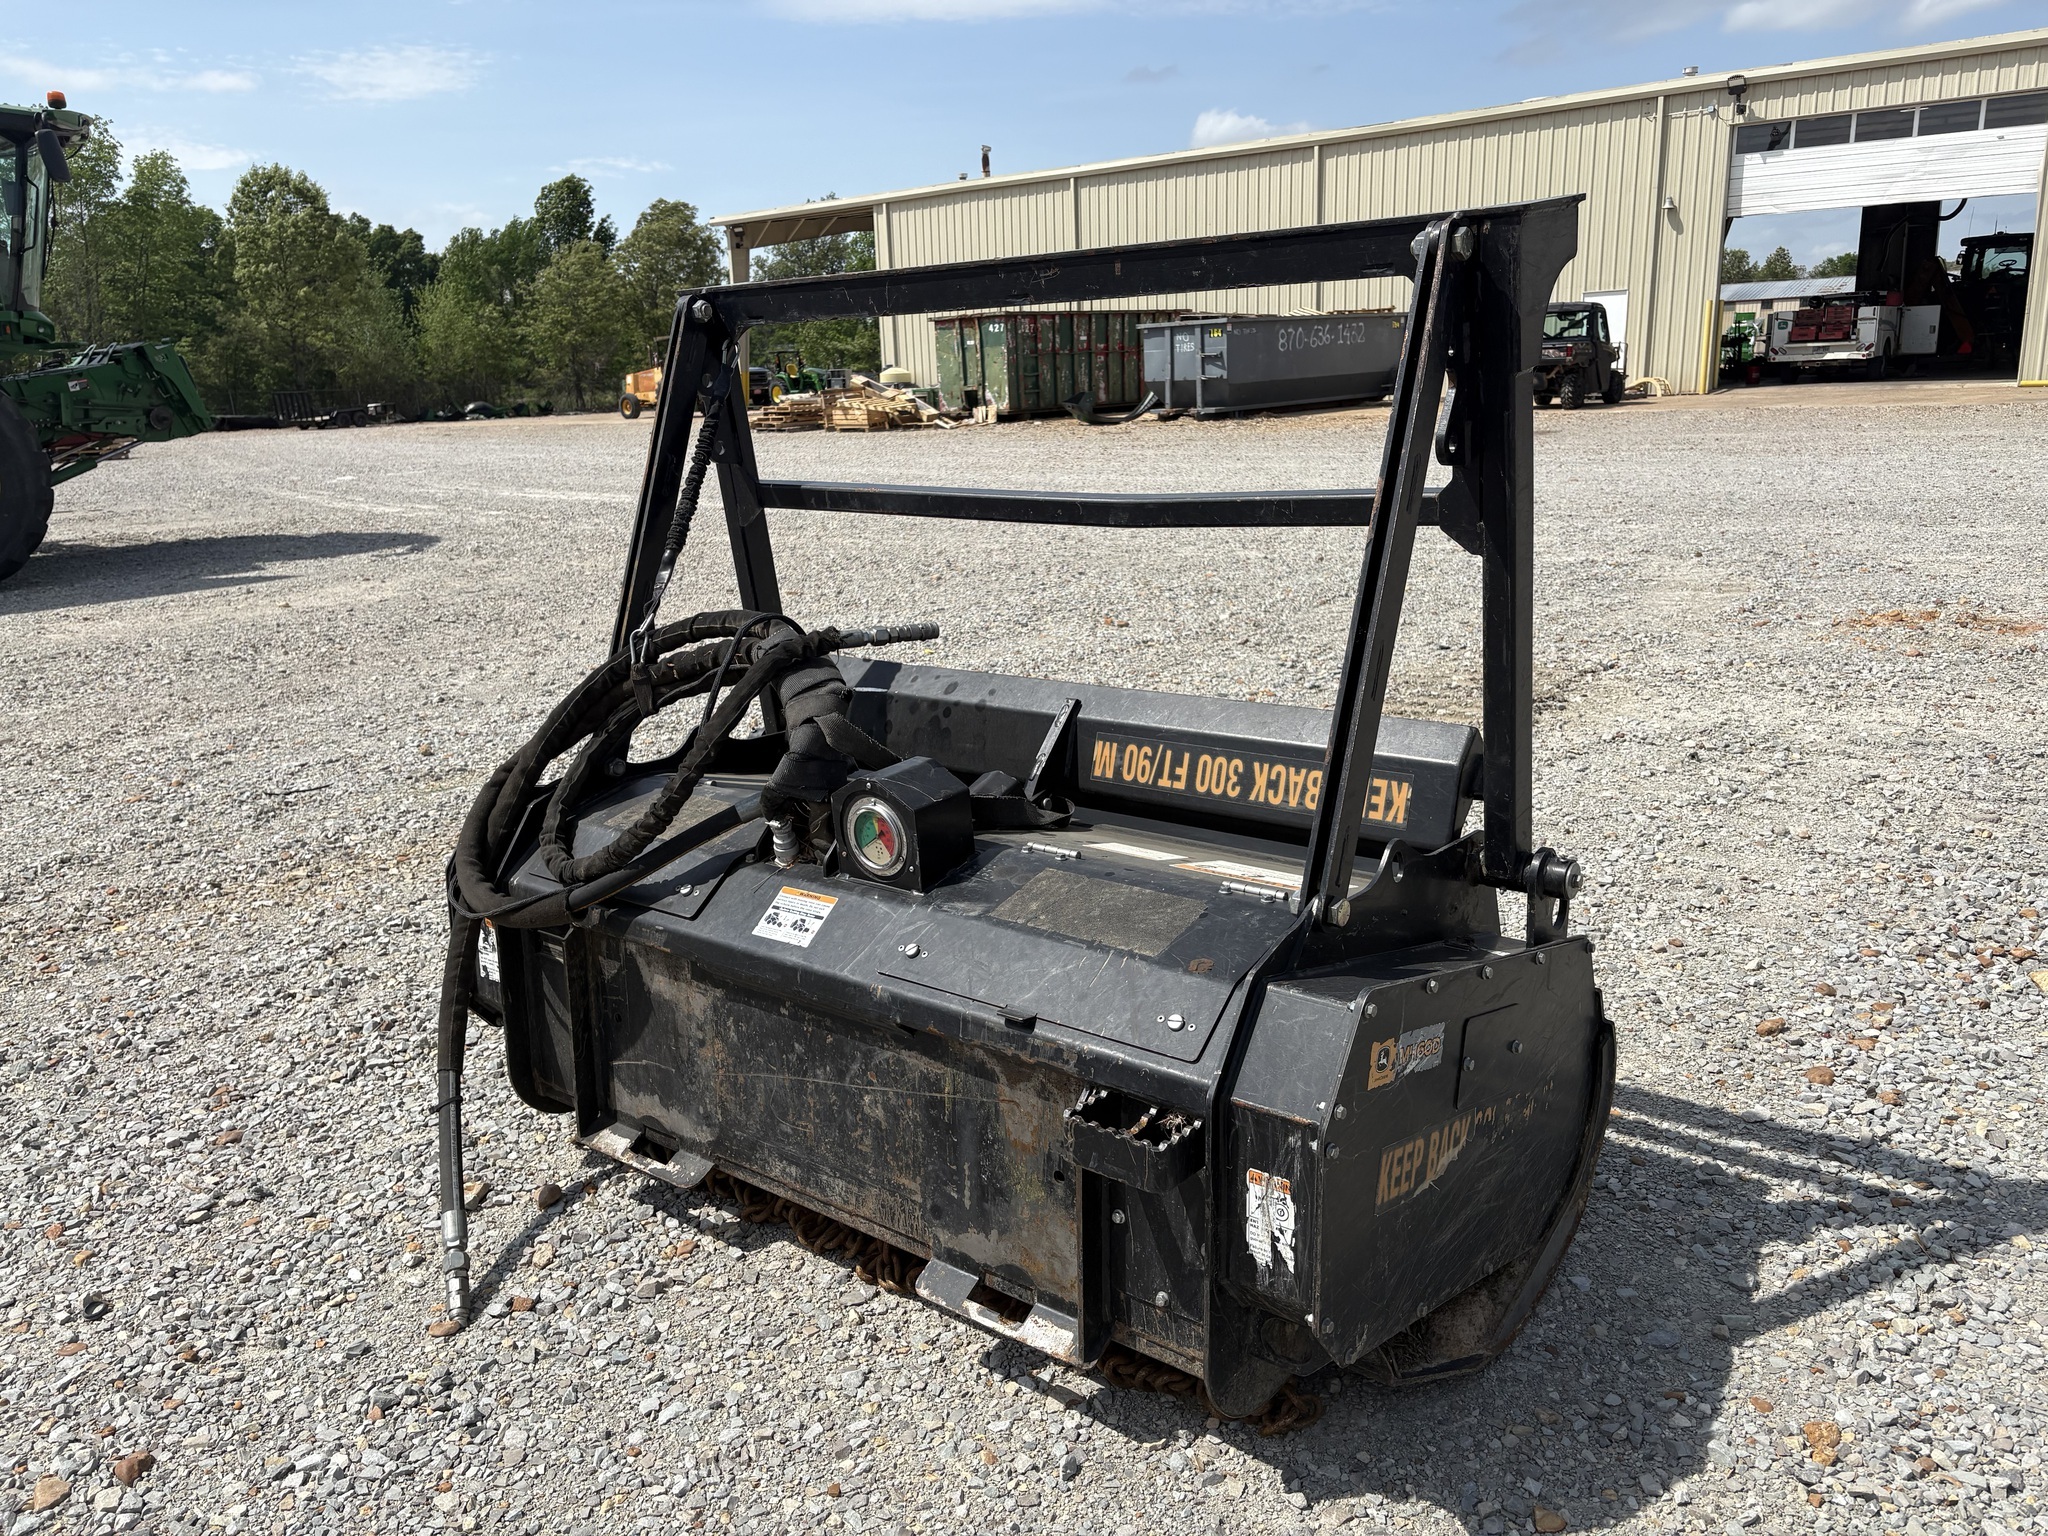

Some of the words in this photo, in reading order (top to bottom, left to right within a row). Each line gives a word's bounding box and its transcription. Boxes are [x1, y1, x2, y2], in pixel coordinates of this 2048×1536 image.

[988, 323, 1005, 333] 427
[1175, 342, 1195, 353] TIRES
[1176, 332, 1190, 342] NO
[1093, 739, 1117, 778] M
[1123, 743, 1190, 790] FT/90
[1196, 754, 1243, 797] 300
[1250, 761, 1323, 811] BACK
[1362, 777, 1410, 824] KE
[1376, 1136, 1424, 1205] KEEP
[1426, 1115, 1472, 1179] BACK
